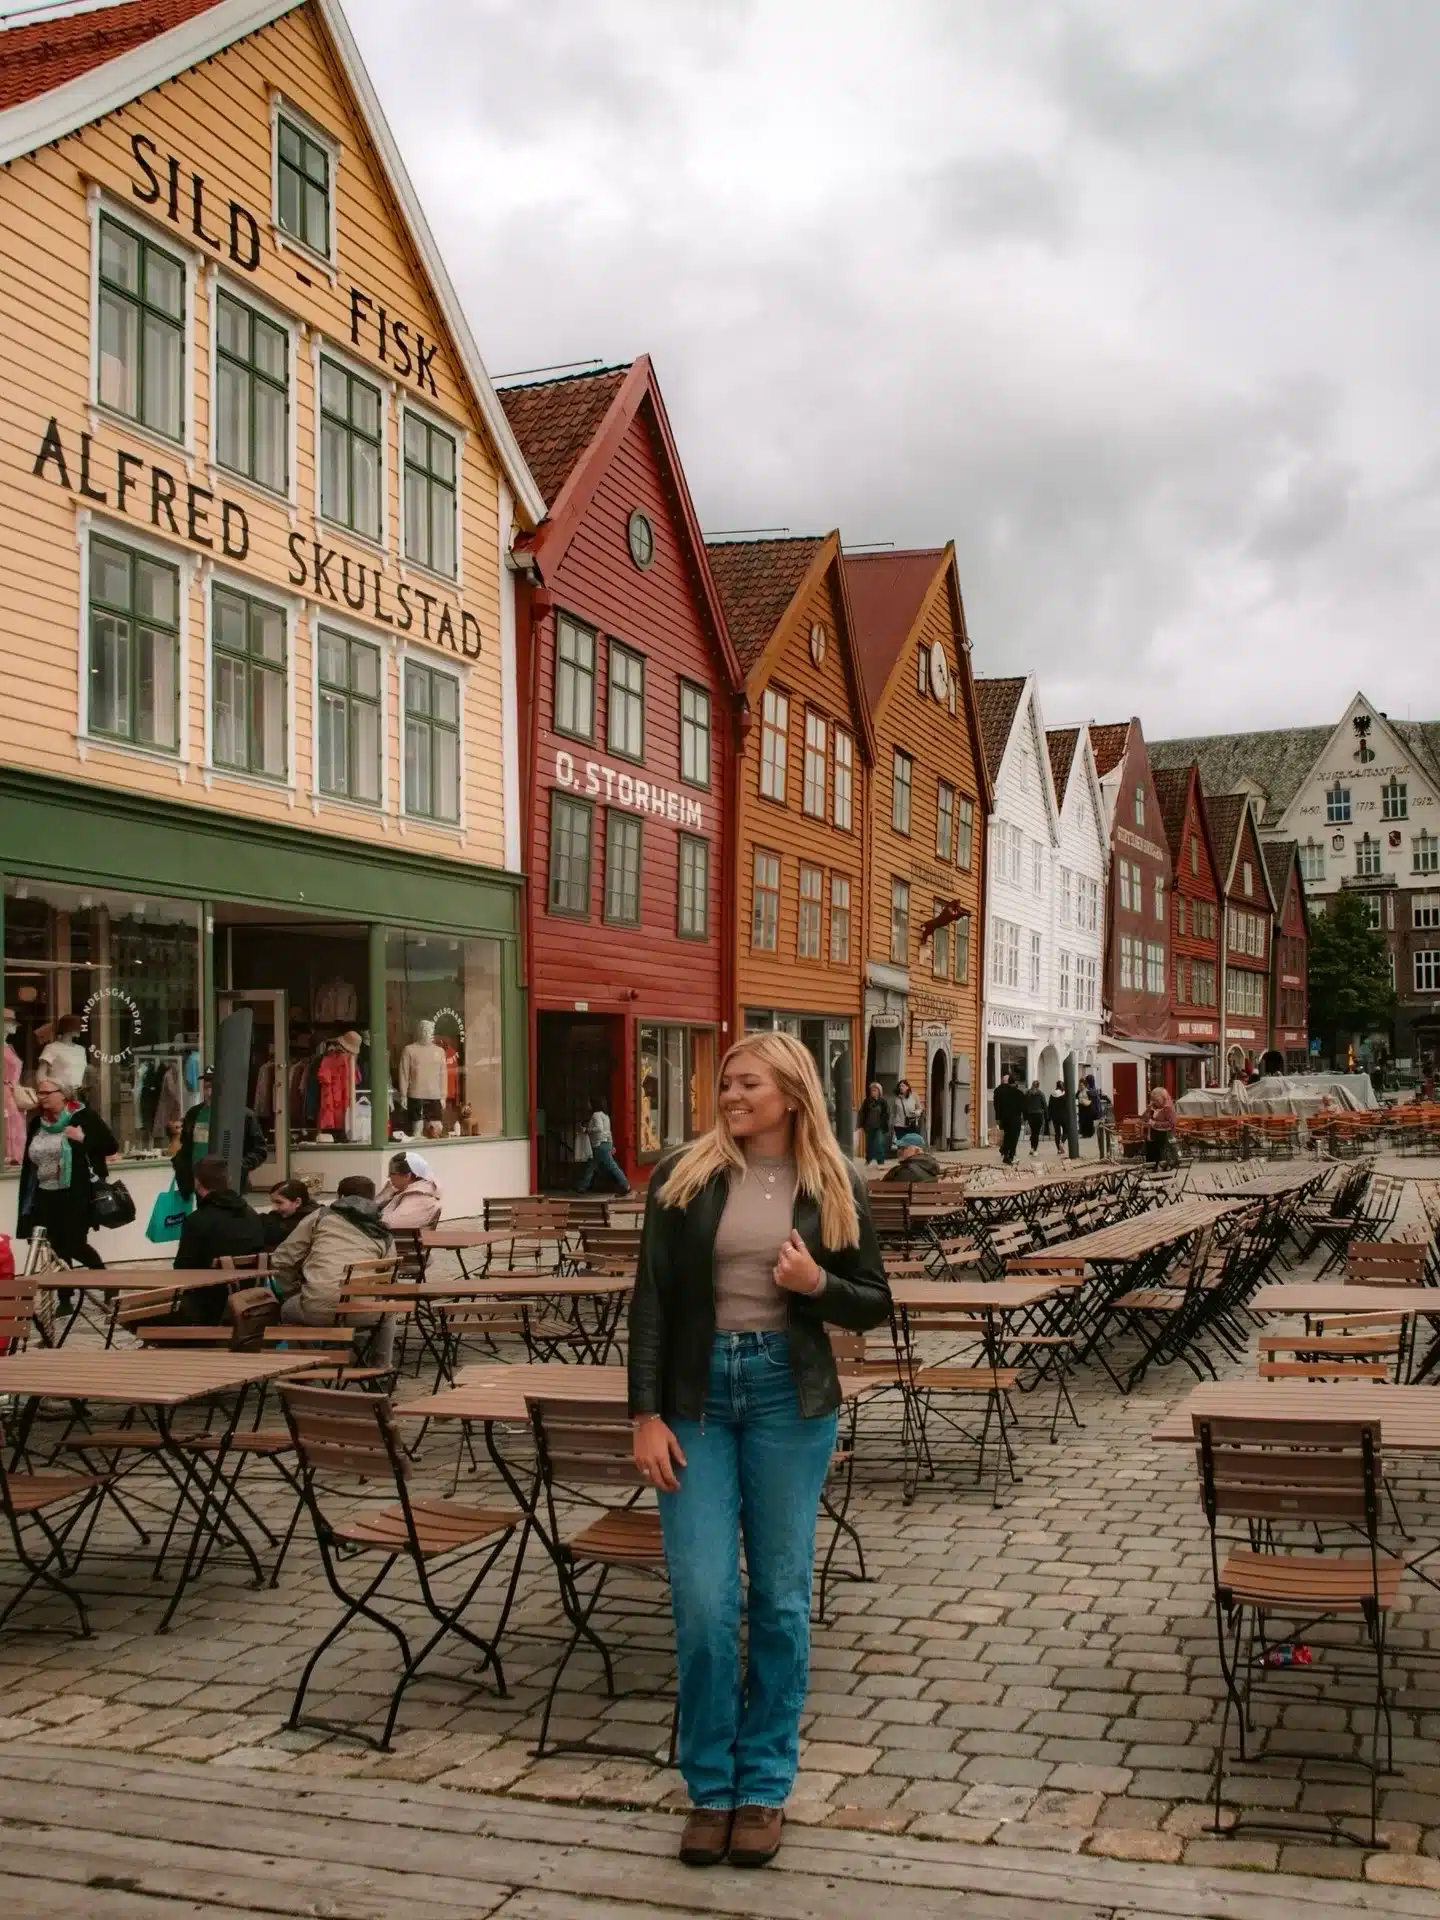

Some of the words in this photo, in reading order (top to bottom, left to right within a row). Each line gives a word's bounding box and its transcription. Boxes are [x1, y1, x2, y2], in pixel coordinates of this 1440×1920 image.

[131, 134, 261, 273] SILD
[349, 286, 439, 399] FISK
[32, 417, 250, 562] ALFRED
[287, 532, 482, 660] SKULSTAD
[586, 761, 702, 829] STORHEIM
[80, 987, 142, 1035] HANDELSGAARDEN
[88, 1044, 132, 1064] SCHJØTT
